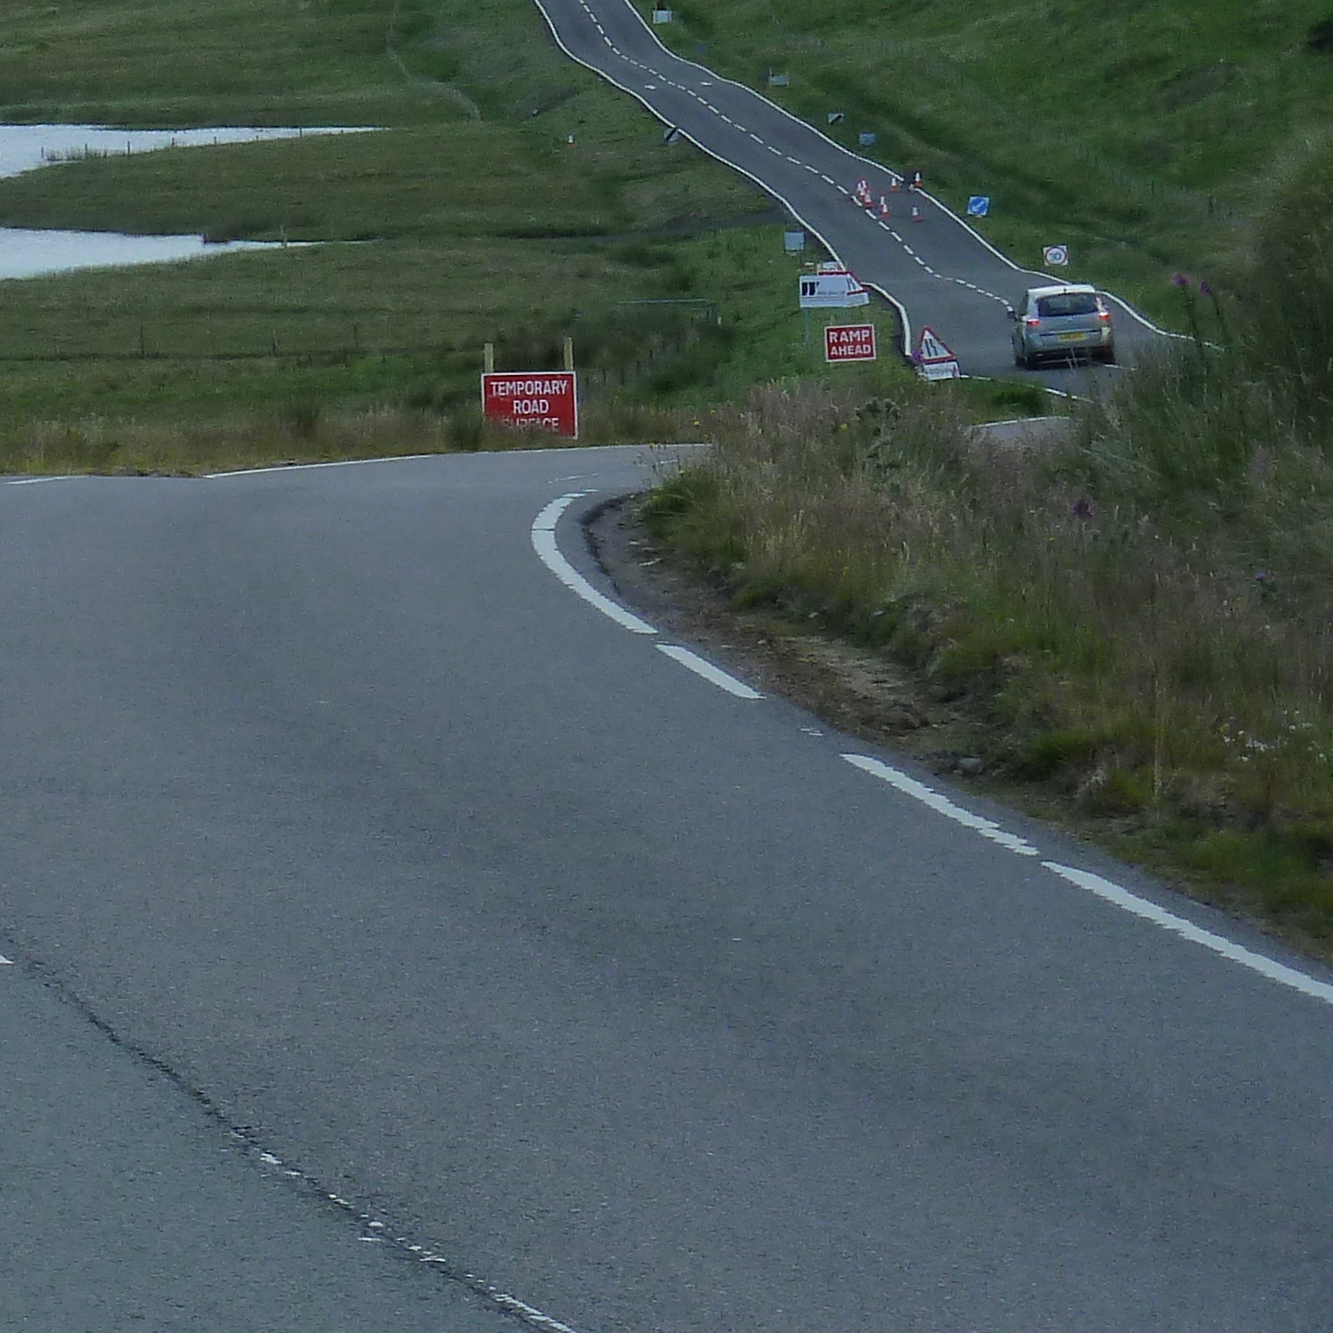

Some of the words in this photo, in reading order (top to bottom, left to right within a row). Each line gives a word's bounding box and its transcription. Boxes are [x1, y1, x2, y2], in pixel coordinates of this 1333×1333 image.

[828, 329, 870, 344] RAMP
[830, 344, 872, 357] AHEAD
[490, 380, 568, 396] TEMPORARY
[513, 399, 550, 415] ROAD
